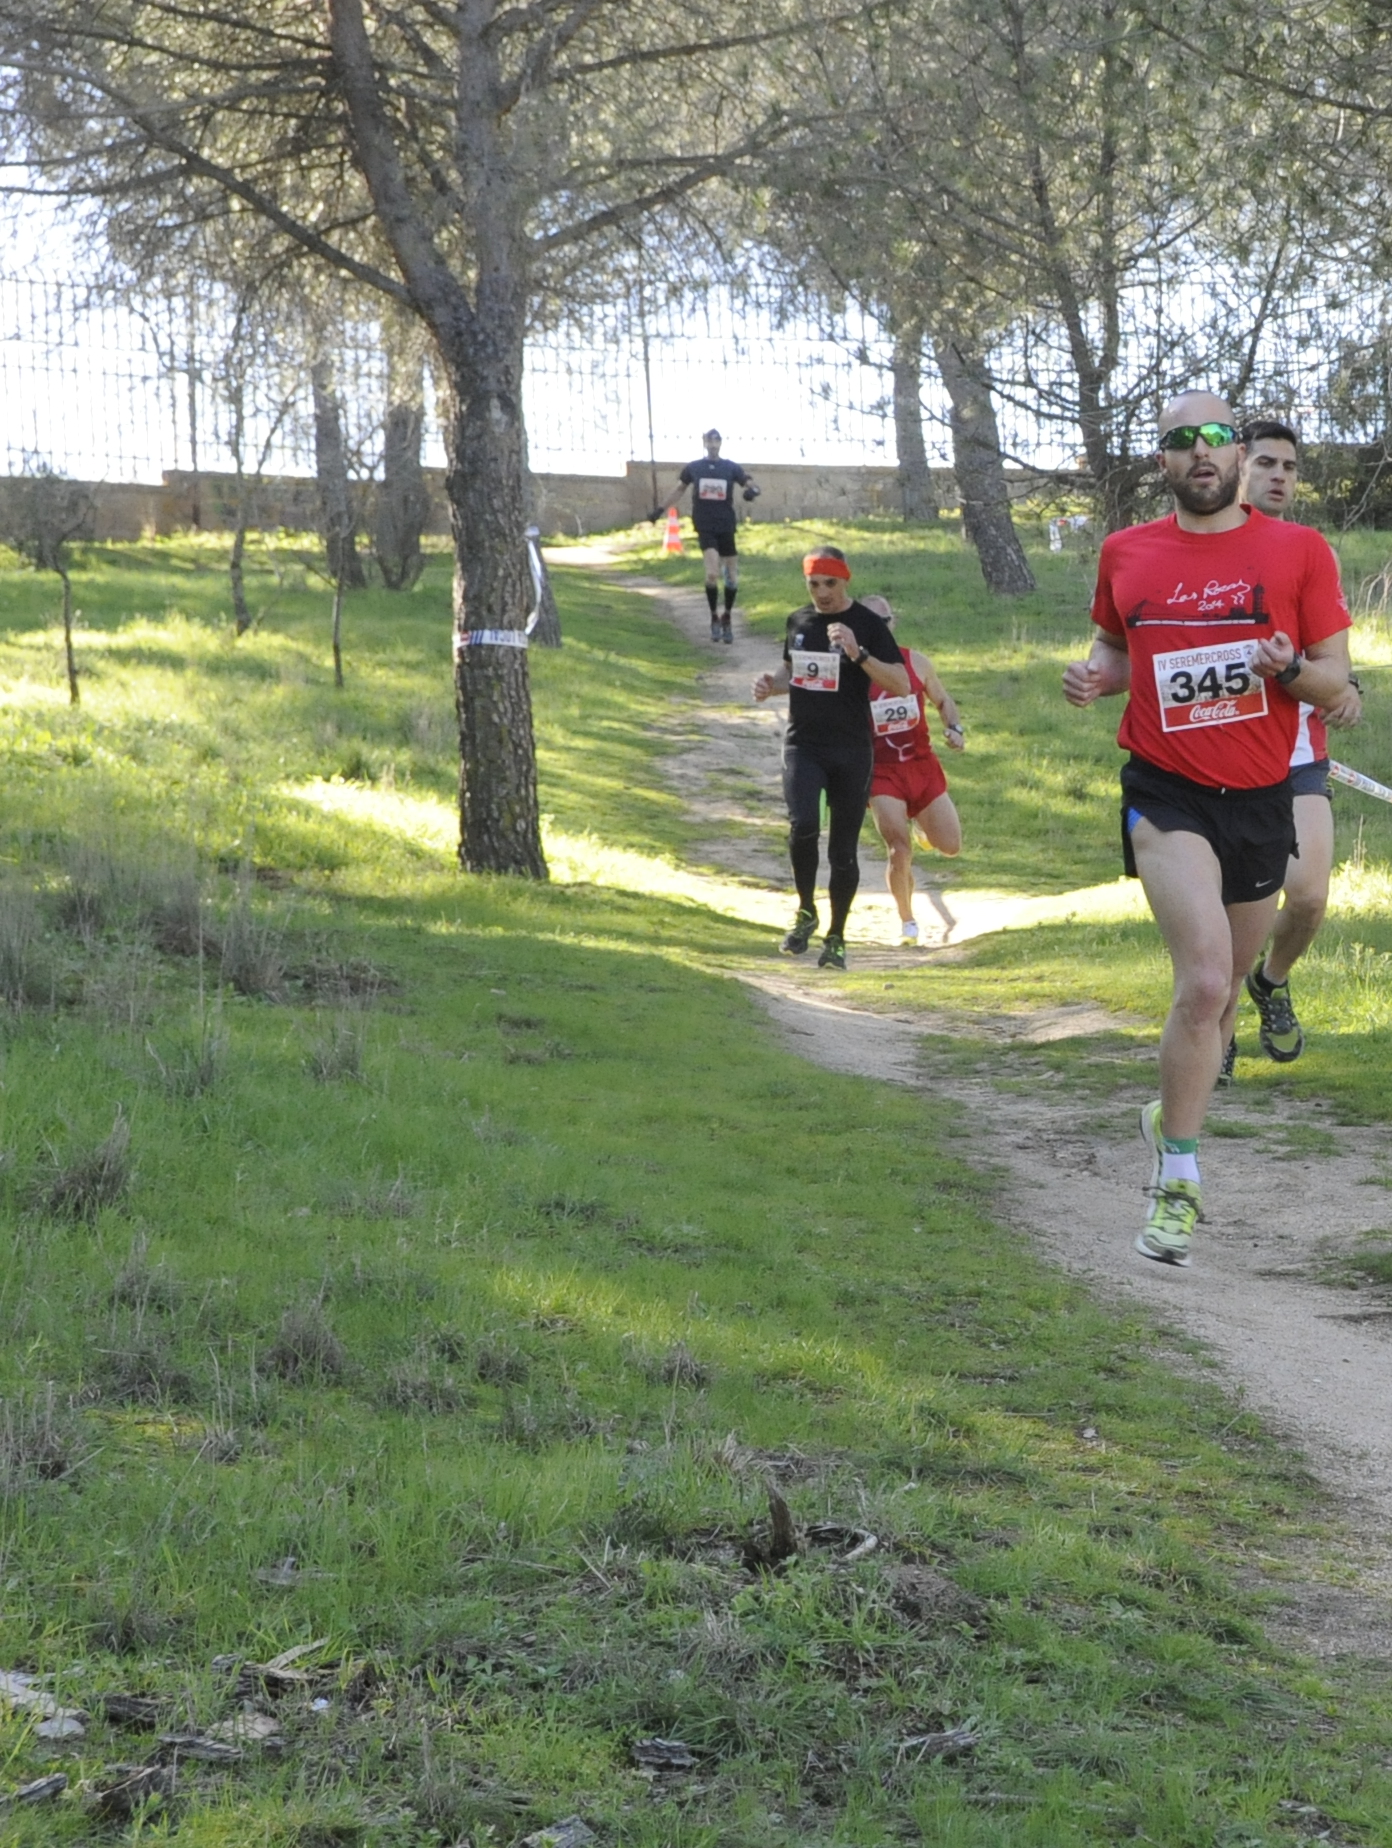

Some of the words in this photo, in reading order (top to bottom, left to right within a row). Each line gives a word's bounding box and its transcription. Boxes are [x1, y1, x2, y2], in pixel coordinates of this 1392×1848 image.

[1197, 600, 1224, 612] 2014
[1158, 660, 1167, 672] IV
[1169, 648, 1242, 670] SEREMERCROSS
[807, 662, 819, 678] 9
[1169, 662, 1251, 704] 345
[885, 706, 908, 722] 29
